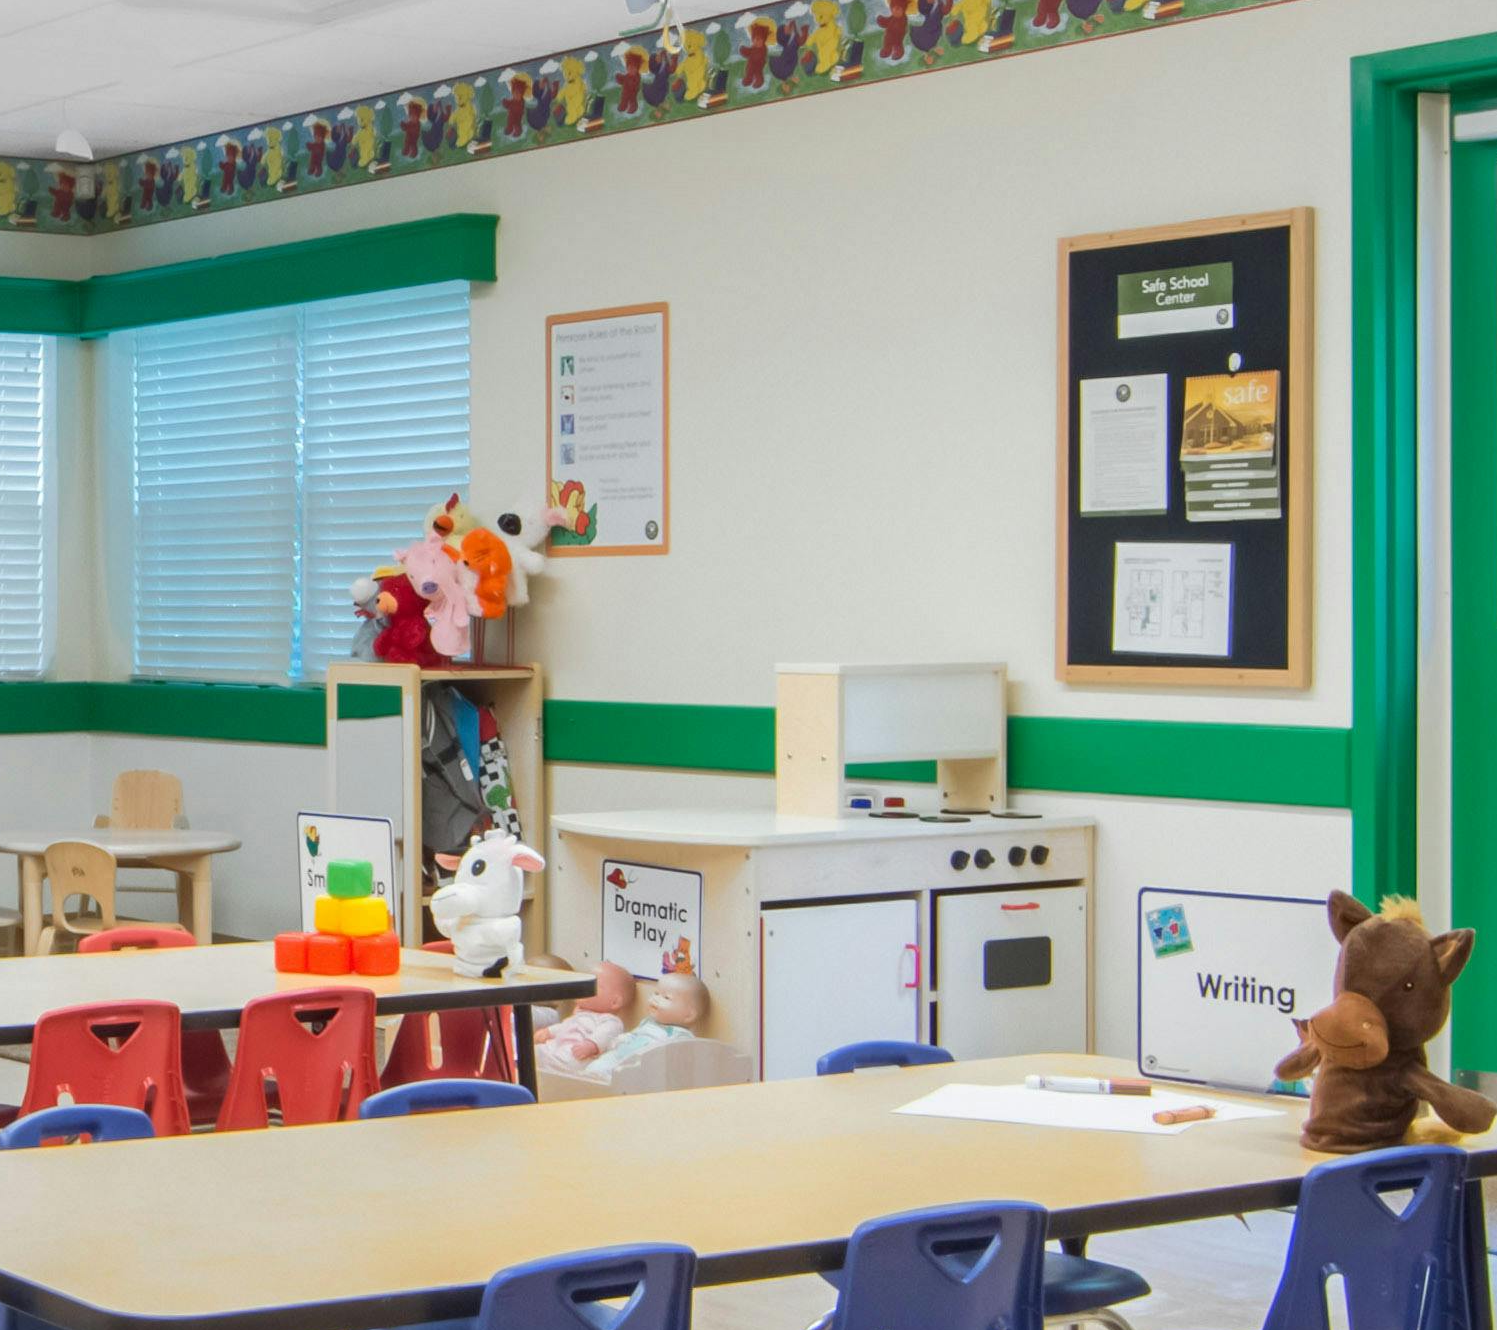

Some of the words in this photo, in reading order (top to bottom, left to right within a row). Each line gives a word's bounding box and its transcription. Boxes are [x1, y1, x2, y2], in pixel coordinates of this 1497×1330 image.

[1142, 277, 1166, 294] Safe
[1170, 273, 1209, 289] School
[1155, 291, 1196, 306] Center
[1223, 379, 1269, 405] safe
[614, 894, 687, 923] Dramatic
[634, 921, 667, 948] Play
[1197, 972, 1296, 1013] Writing
